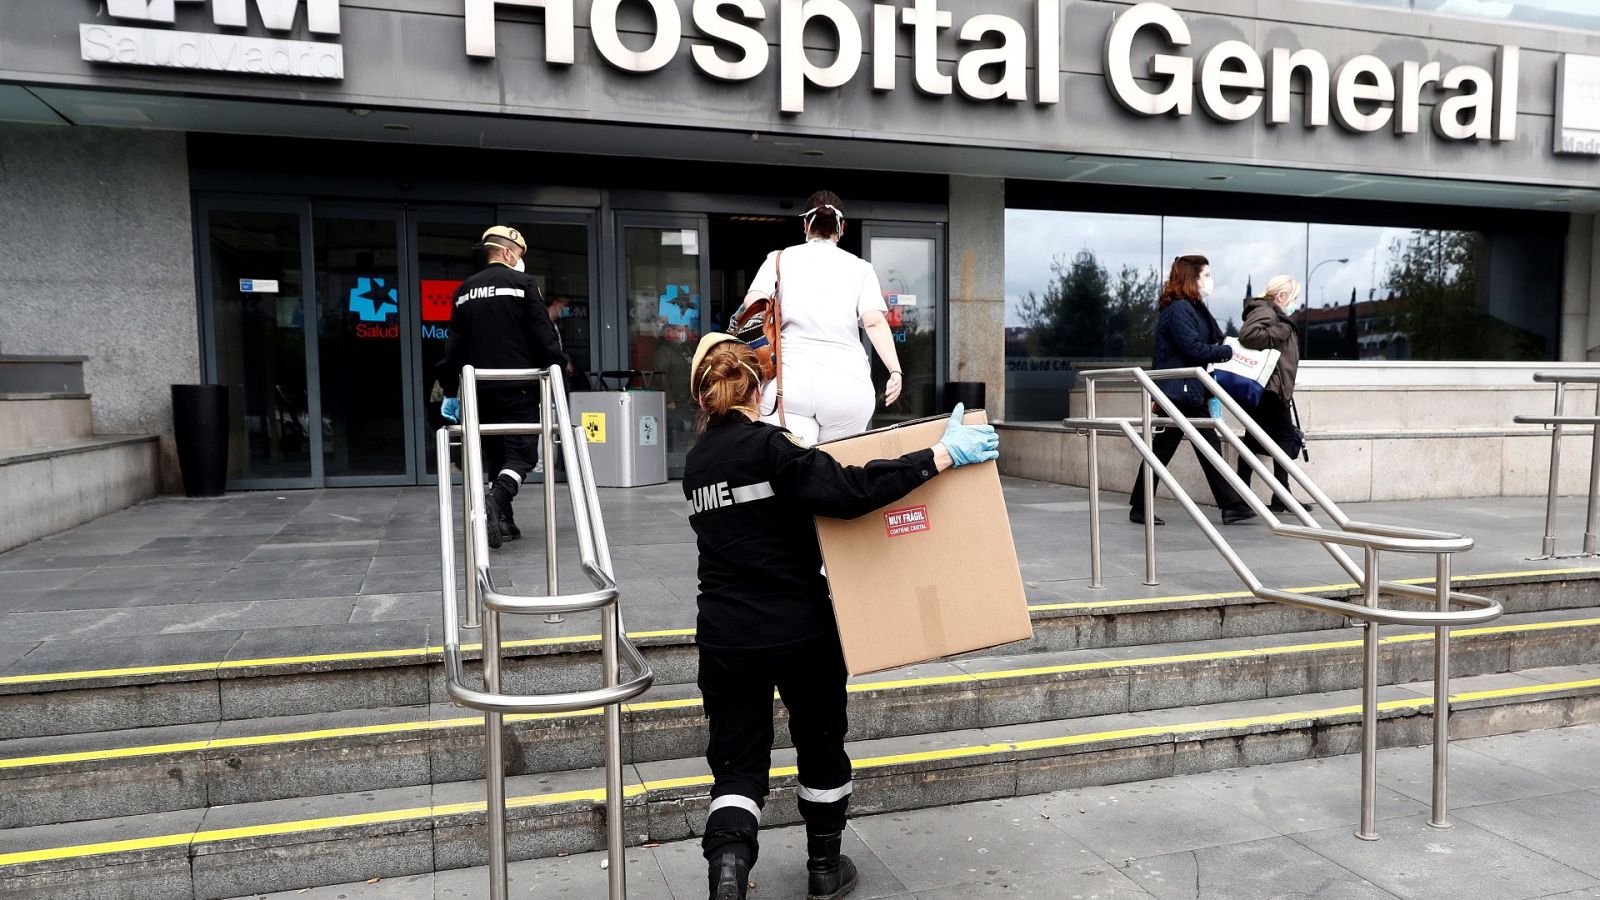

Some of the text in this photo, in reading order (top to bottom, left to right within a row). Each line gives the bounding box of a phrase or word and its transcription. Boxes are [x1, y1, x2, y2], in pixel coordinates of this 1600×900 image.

[83, 26, 342, 79] SaludMadrid
[1104, 3, 1520, 141] General
[469, 286, 496, 299] UME
[356, 324, 399, 338] Salud
[692, 481, 733, 514] UME
[889, 514, 902, 525] MUY
[890, 523, 927, 535] CONTIENE CRISTAL
